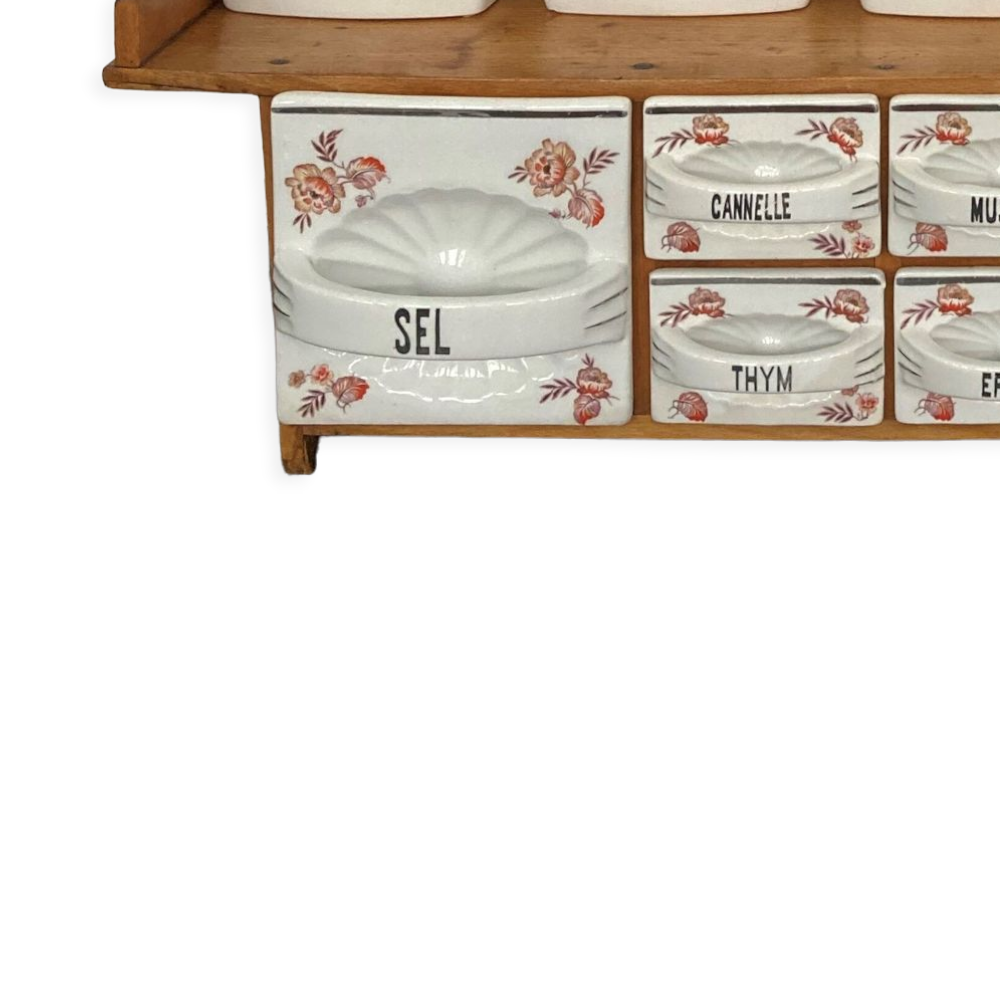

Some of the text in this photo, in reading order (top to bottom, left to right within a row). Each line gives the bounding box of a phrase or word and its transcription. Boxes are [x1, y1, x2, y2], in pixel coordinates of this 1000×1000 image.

[711, 192, 792, 221] CANNELLE
[394, 307, 451, 356] SEL
[731, 365, 793, 393] THYM
